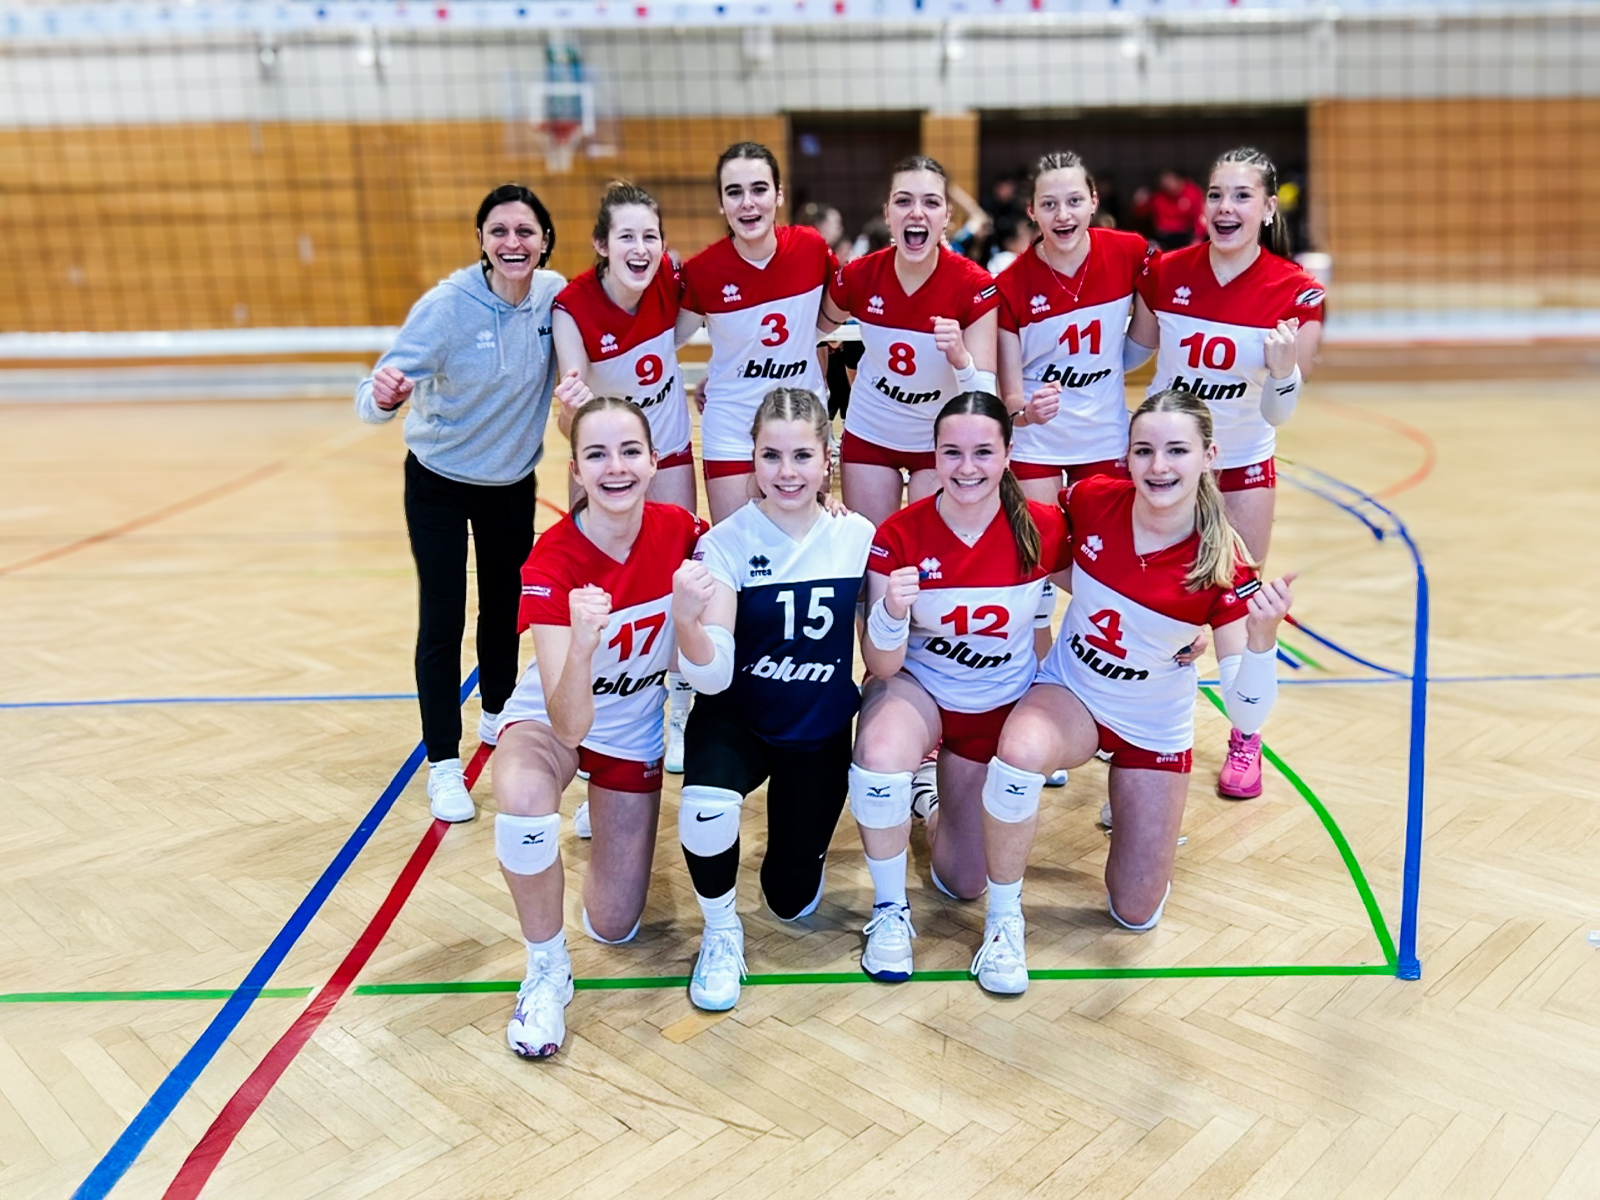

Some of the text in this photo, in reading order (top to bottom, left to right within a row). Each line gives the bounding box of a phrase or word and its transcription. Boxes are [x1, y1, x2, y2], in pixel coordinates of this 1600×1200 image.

[761, 313, 789, 347] 3
[1059, 319, 1101, 355] 11
[888, 342, 916, 376] 8
[1180, 332, 1236, 370] 10
[635, 354, 663, 386] 9
[743, 358, 807, 379] blum
[1041, 364, 1111, 388] blum
[876, 376, 941, 404] blum
[1171, 375, 1247, 400] blum
[775, 587, 835, 640] 15
[941, 605, 1009, 640] 12
[608, 611, 666, 663] 17
[925, 636, 1012, 669] blum
[751, 655, 835, 683] blum
[1070, 633, 1149, 680] blum
[591, 669, 668, 697] blum
